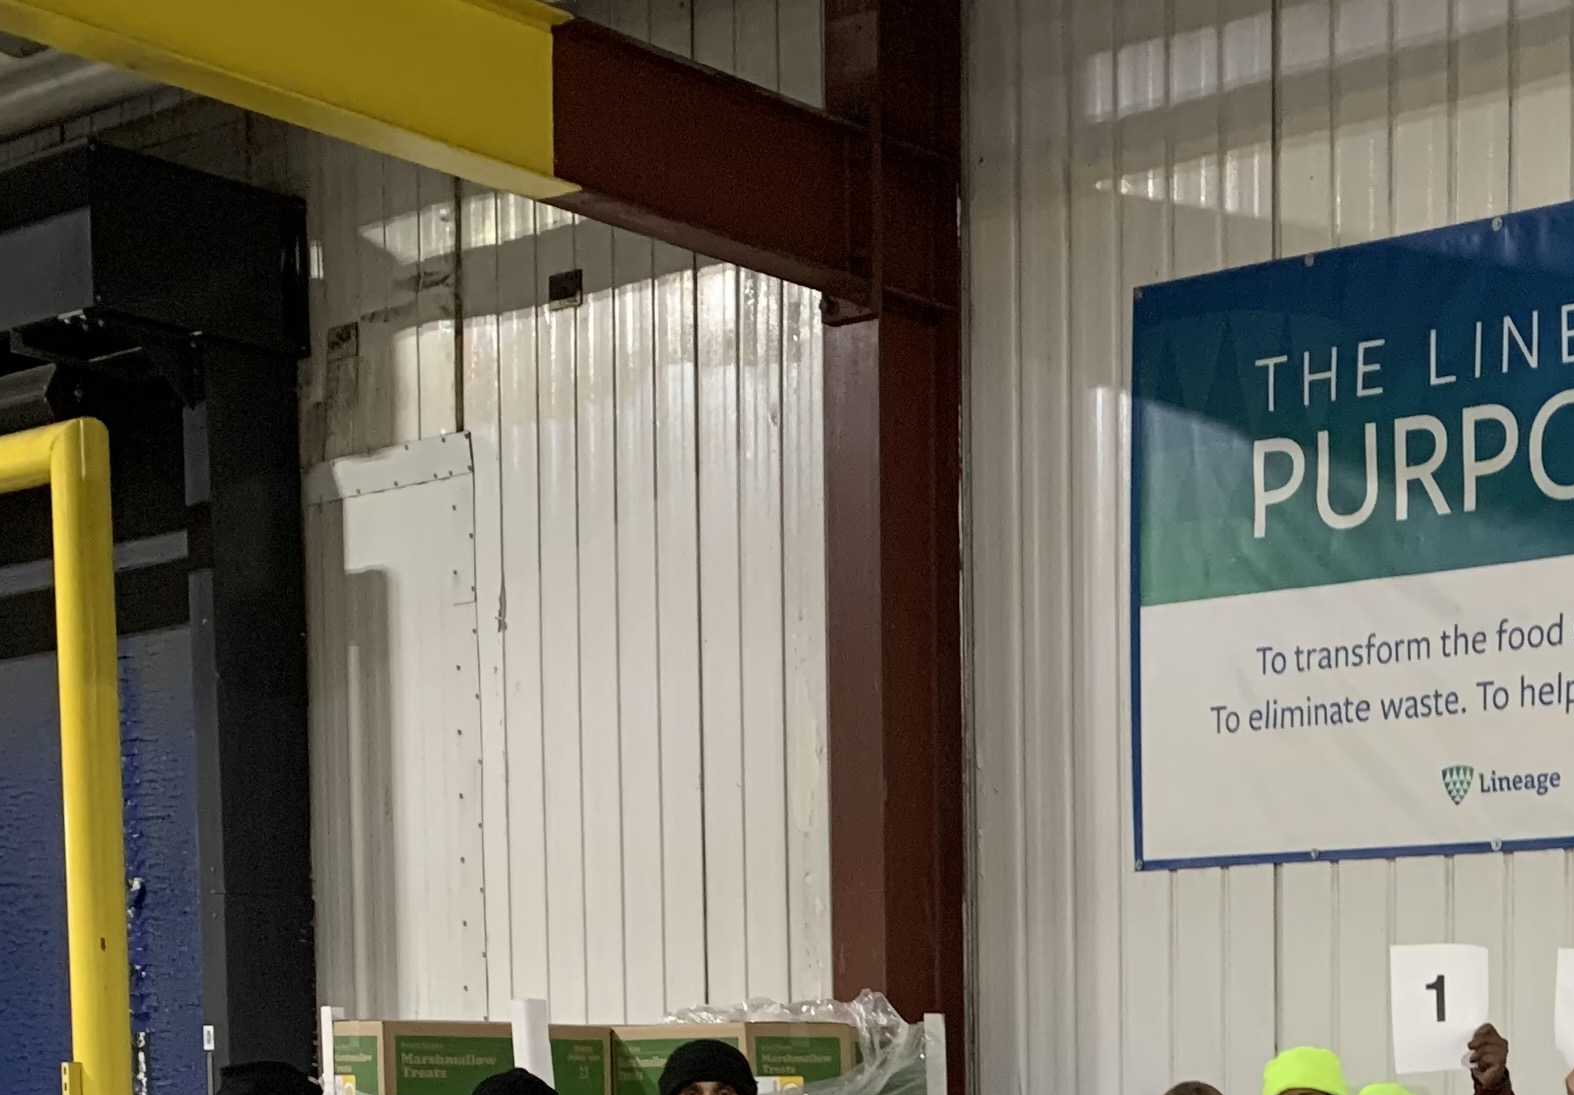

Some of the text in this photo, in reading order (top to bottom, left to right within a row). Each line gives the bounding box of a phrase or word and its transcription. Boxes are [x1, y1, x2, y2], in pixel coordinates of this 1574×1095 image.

[1254, 338, 1386, 412] THE
[1256, 646, 1287, 675] To
[1295, 633, 1431, 673] transform
[1440, 624, 1487, 657] the
[1496, 612, 1564, 652] food
[1210, 706, 1240, 734] To
[1249, 696, 1371, 731] eliminate
[1380, 689, 1467, 720] waste.
[1476, 680, 1509, 712] To
[1479, 771, 1561, 796] Lineage
[1424, 974, 1447, 1023] 1
[401, 1052, 497, 1067] Marshmallow
[402, 1066, 448, 1079] Treats
